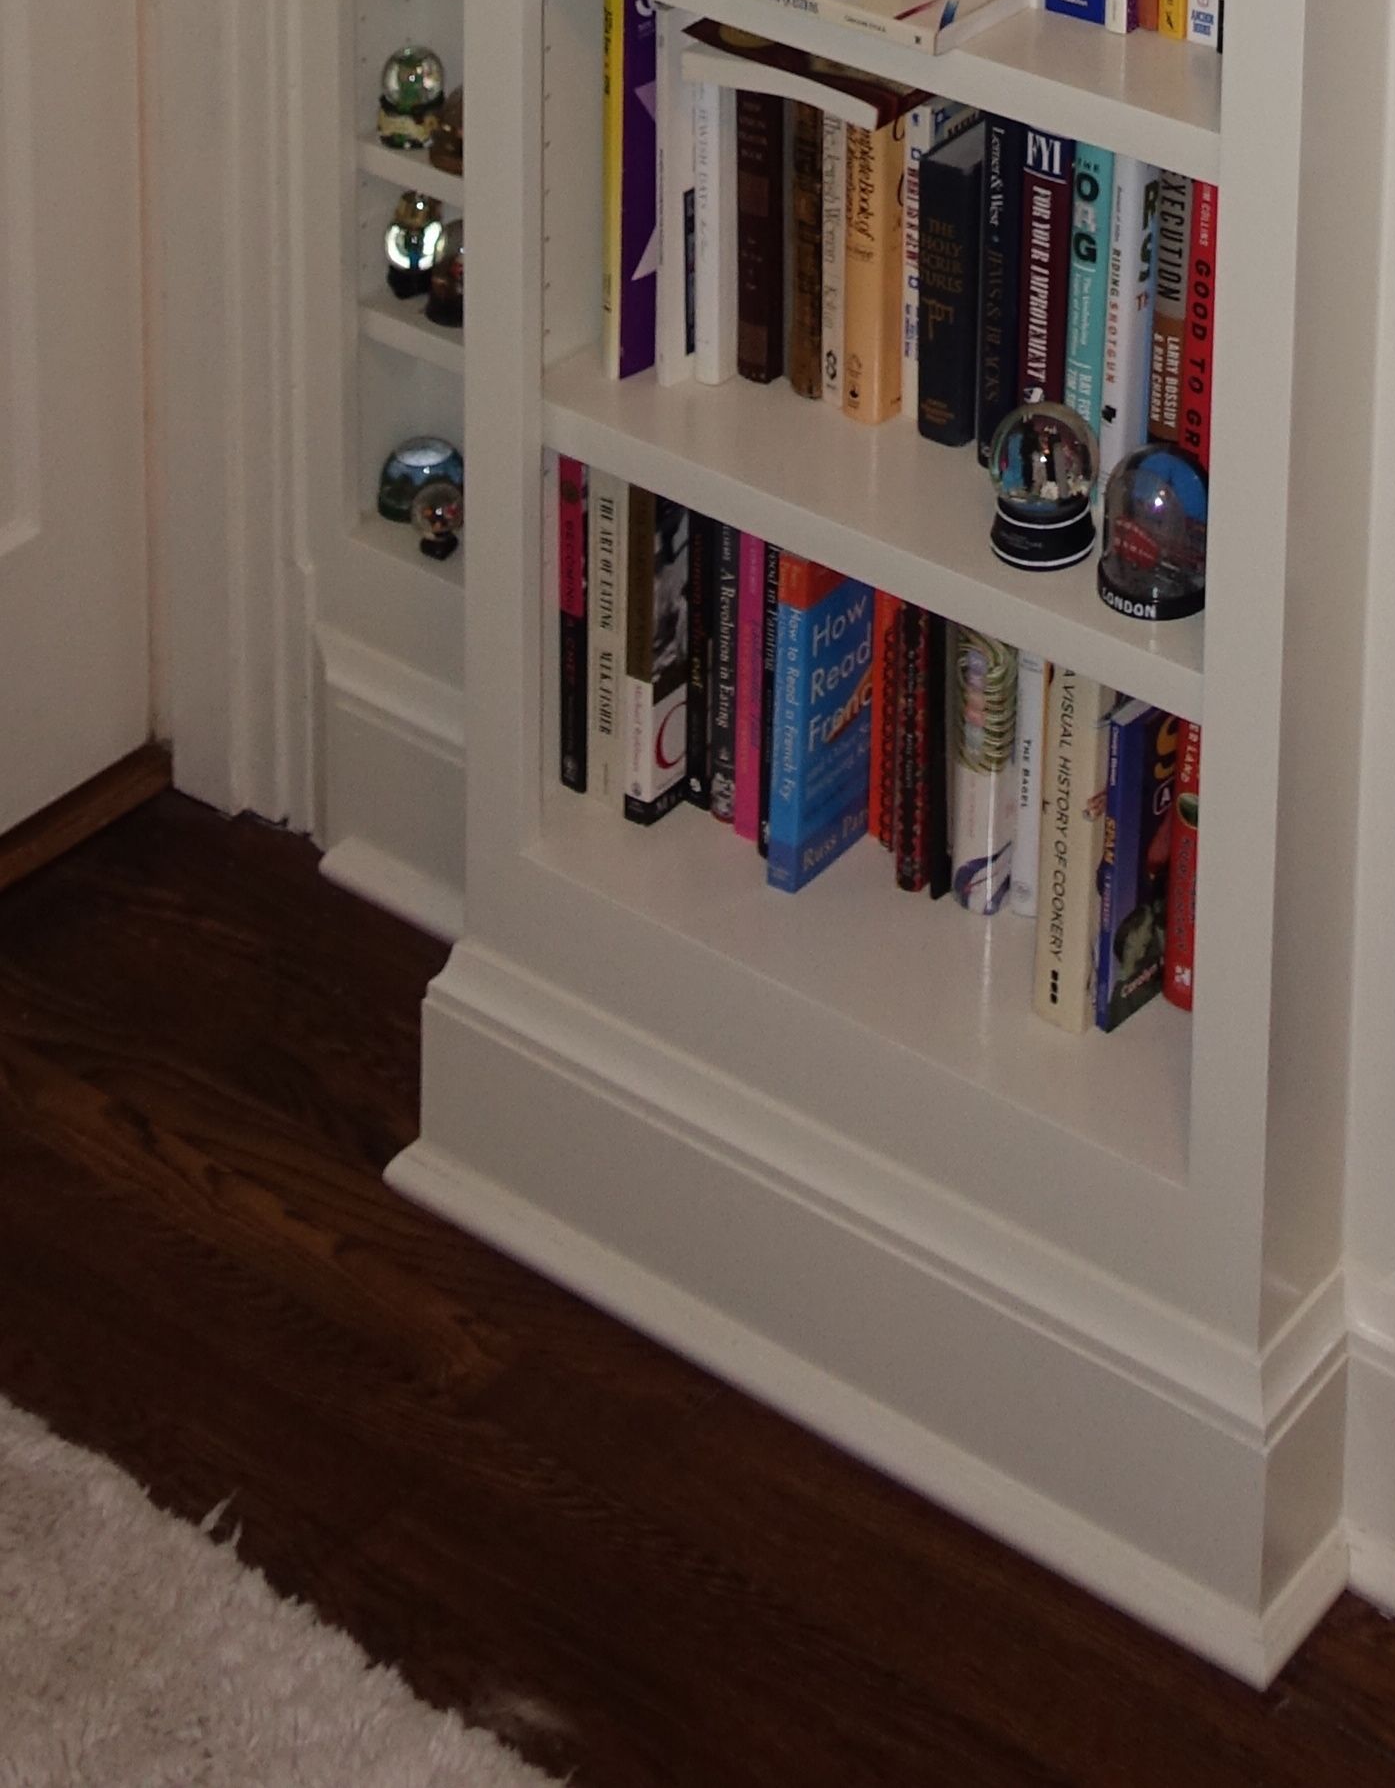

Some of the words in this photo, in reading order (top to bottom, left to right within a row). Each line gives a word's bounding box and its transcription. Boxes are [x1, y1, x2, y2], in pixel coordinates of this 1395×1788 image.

[1026, 132, 1066, 176] FYI
[1034, 185, 1051, 218] FOR
[1031, 222, 1049, 262] YOUR
[1026, 267, 1047, 383] IMPROVEMENT
[1102, 587, 1158, 619] LONDON
[1063, 670, 1077, 682] A
[1059, 688, 1076, 752] VISUAL
[1055, 755, 1074, 834] HISTORY
[1053, 836, 1068, 869] OF
[1049, 871, 1067, 962] COOKERY
